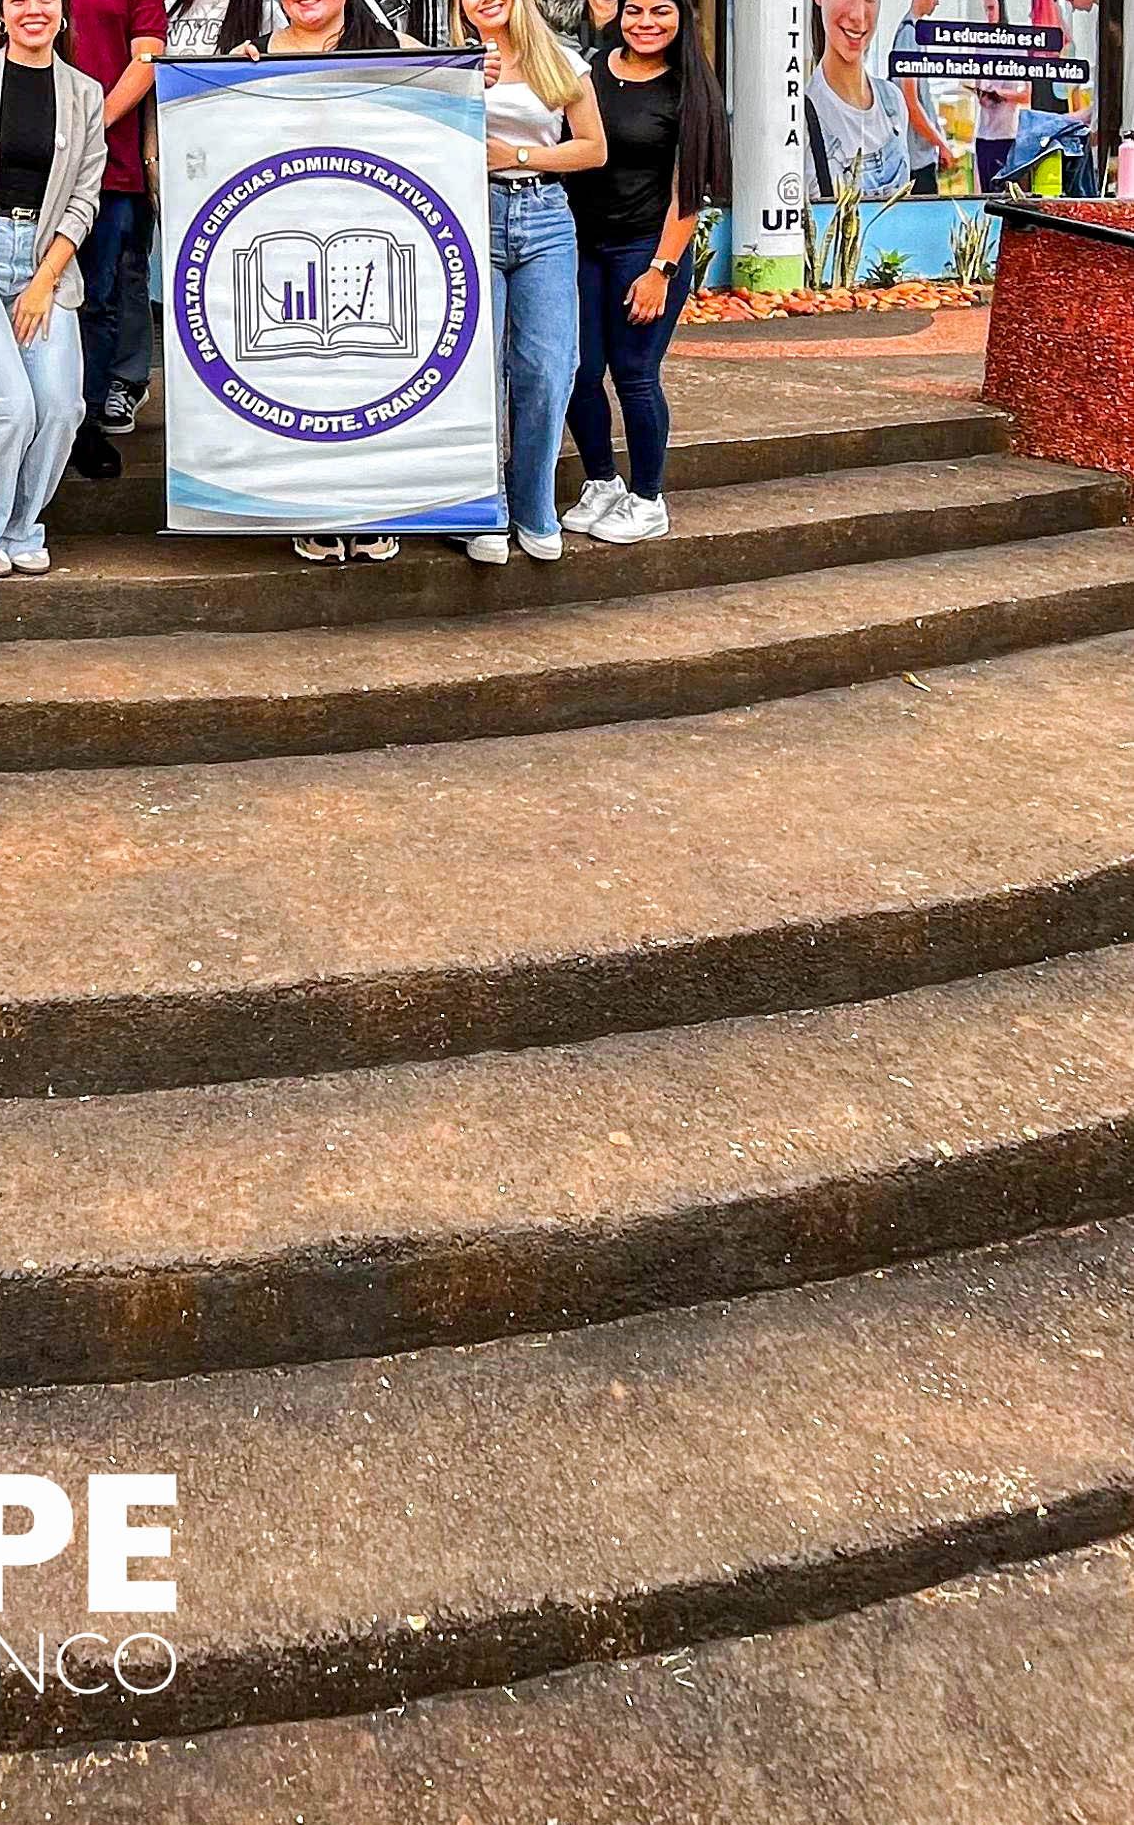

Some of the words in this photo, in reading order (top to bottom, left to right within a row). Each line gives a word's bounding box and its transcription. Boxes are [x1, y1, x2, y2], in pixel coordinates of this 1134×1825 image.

[895, 57, 944, 74] camino
[945, 58, 981, 76] hacia
[982, 60, 993, 76] el
[995, 59, 1026, 78] éxito
[1028, 65, 1044, 78] en
[1045, 62, 1058, 79] la
[1059, 63, 1084, 80] vida
[934, 27, 951, 42] La
[952, 28, 1016, 46] educación
[1017, 33, 1032, 47] es
[1033, 32, 1046, 47] el
[202, 168, 277, 235] CIENCIAS
[280, 156, 442, 226] ADMINISTRATIVAS
[189, 236, 211, 264] DE
[437, 225, 454, 241] Y
[185, 266, 218, 363] FACULTAD
[436, 244, 467, 359] CONTABLES
[221, 379, 296, 428] CIUDAD
[299, 413, 363, 433] PDTE.
[364, 367, 442, 426] FRANCO
